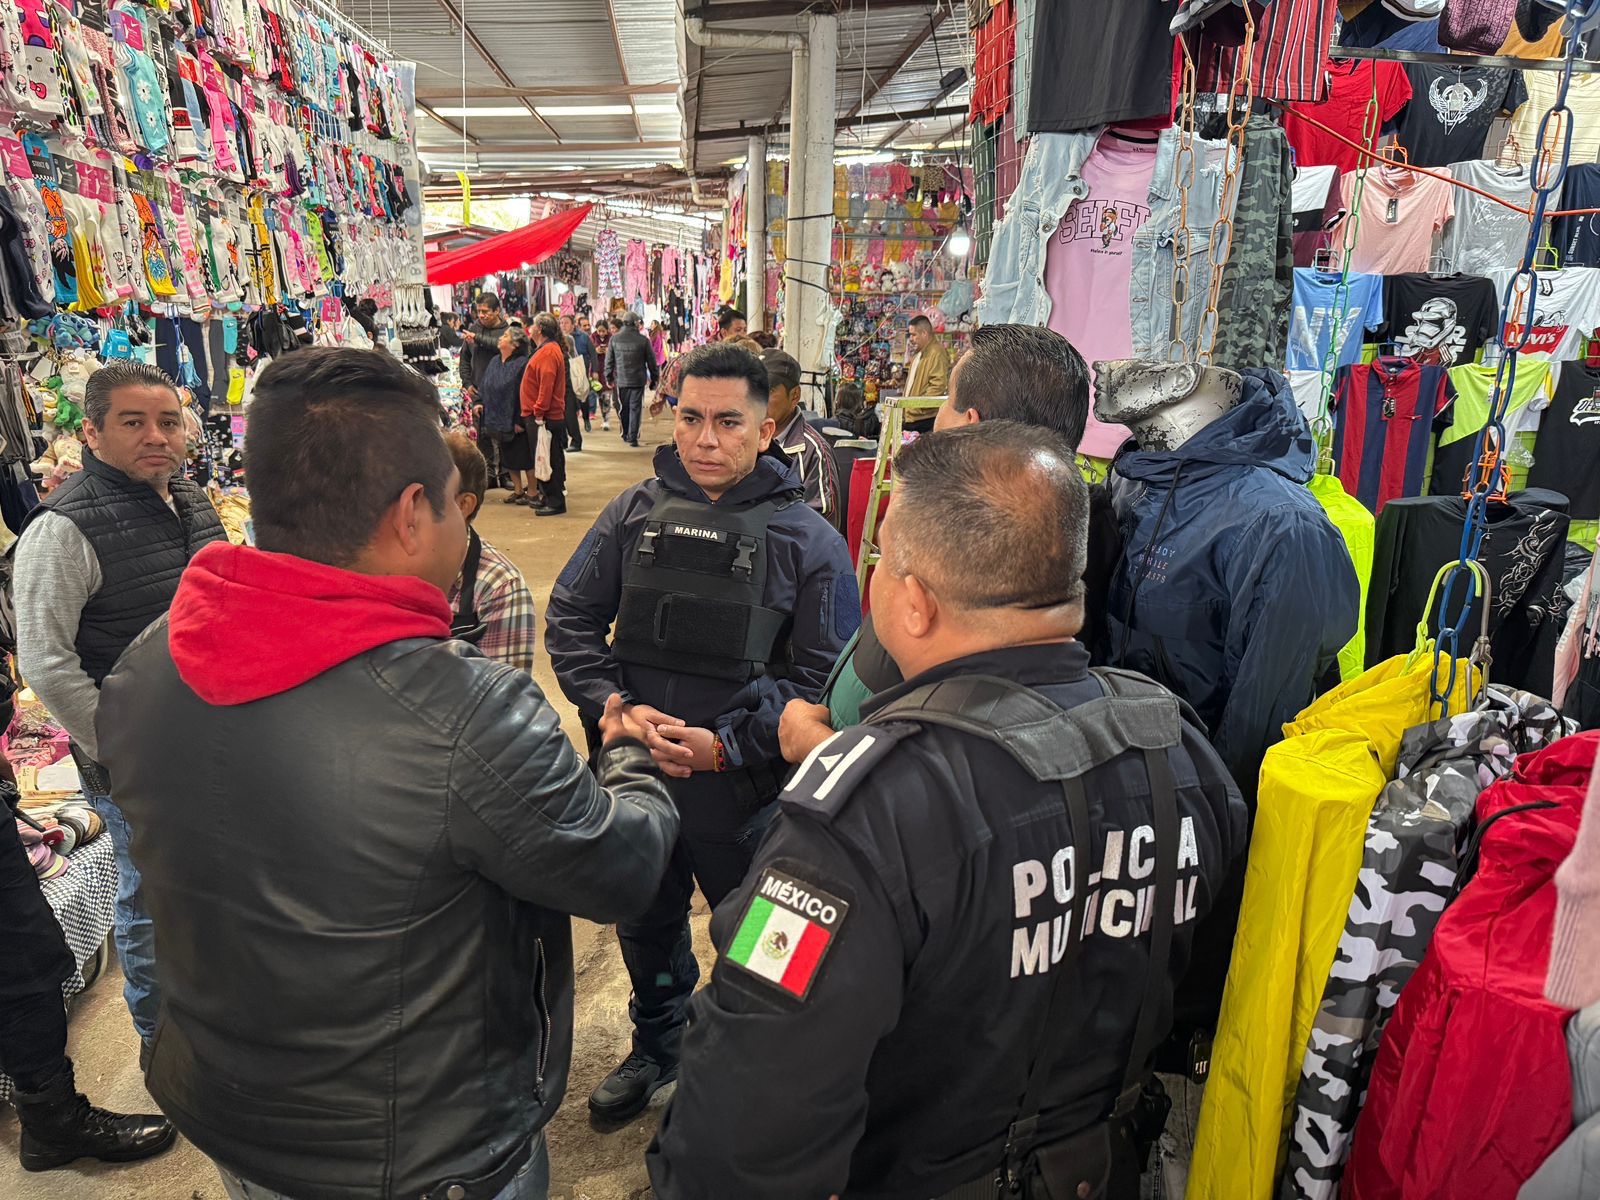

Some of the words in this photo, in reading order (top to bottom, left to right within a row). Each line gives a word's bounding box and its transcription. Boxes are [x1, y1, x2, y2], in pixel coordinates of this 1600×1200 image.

[674, 526, 718, 540] MARINA
[1142, 571, 1167, 583] ASTS
[1013, 816, 1199, 918] POICA
[760, 875, 837, 925] MÉXICO
